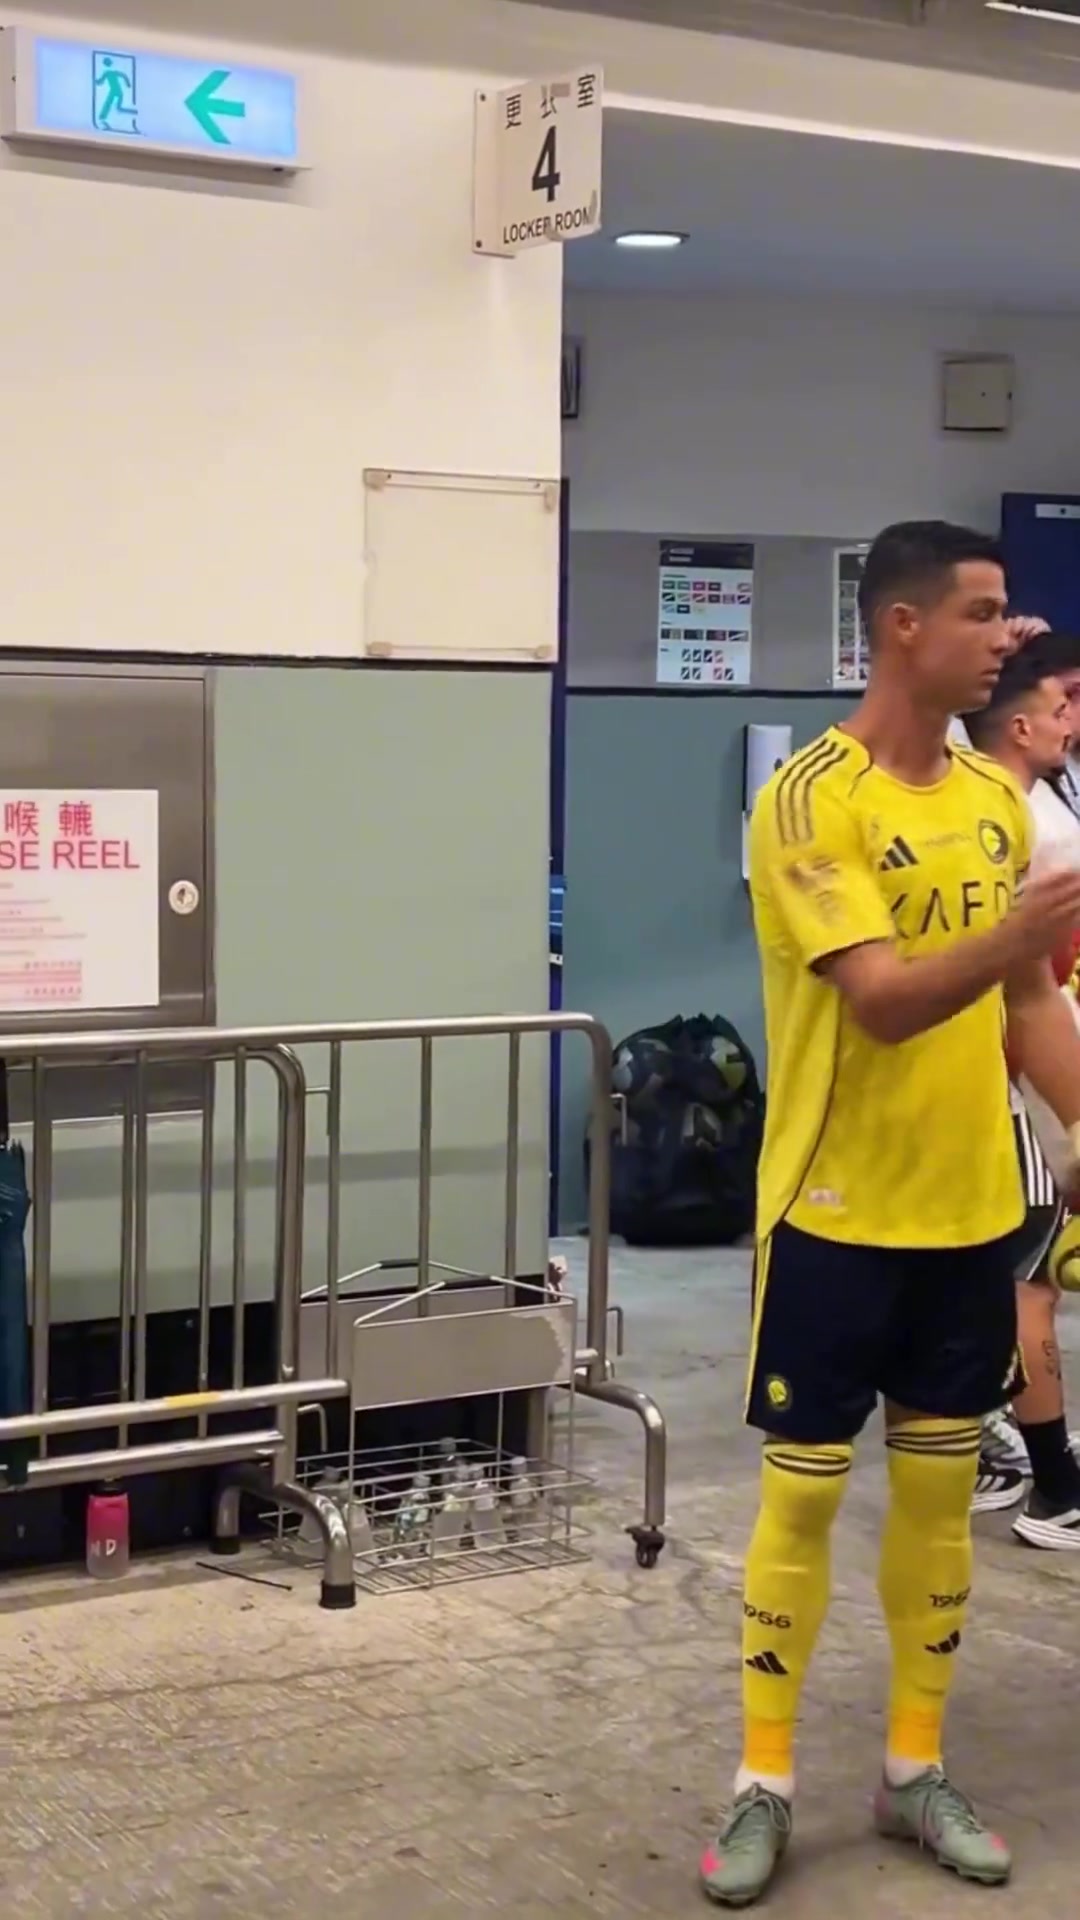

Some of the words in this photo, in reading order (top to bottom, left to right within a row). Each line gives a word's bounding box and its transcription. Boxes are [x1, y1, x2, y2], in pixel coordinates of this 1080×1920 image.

[531, 125, 560, 203] 4
[503, 215, 552, 244] LOCKER
[52, 839, 140, 870] REEL
[929, 1586, 971, 1608] 195
